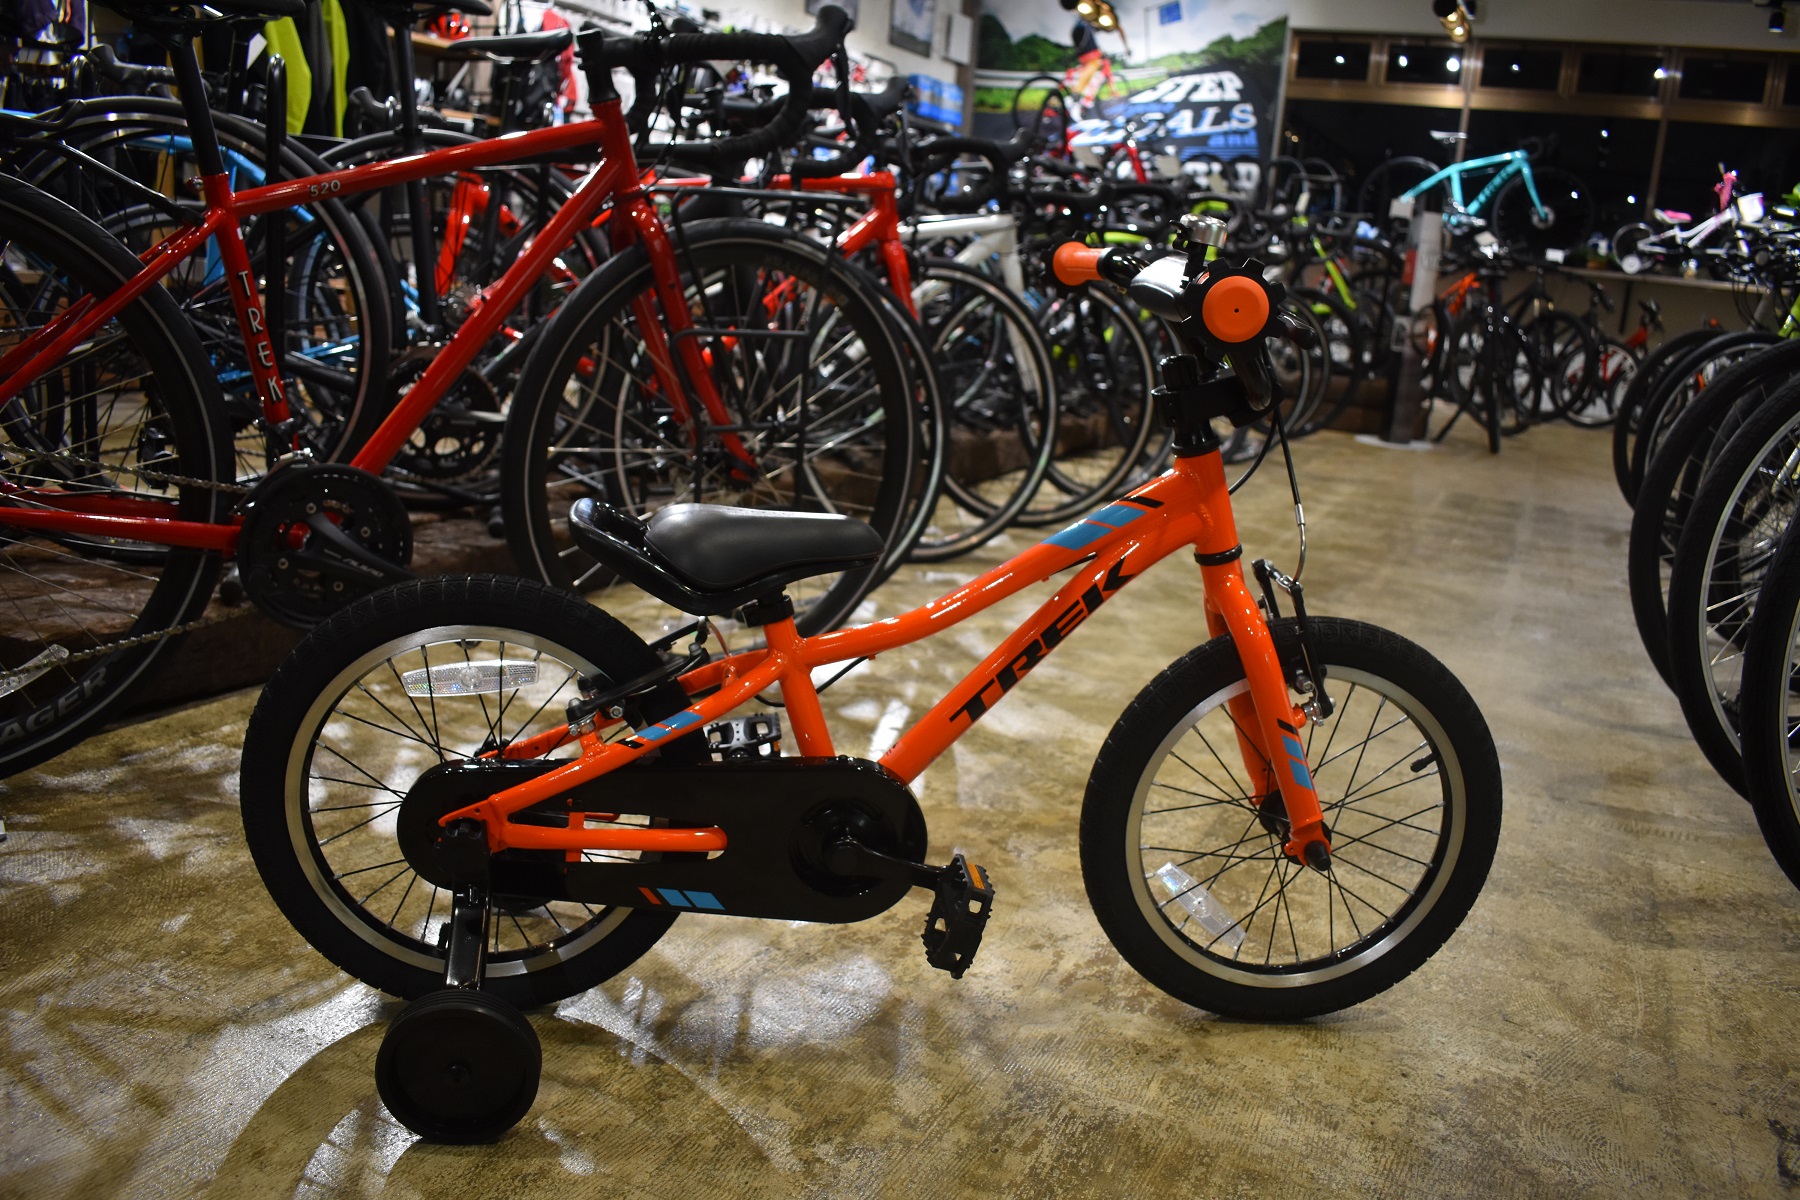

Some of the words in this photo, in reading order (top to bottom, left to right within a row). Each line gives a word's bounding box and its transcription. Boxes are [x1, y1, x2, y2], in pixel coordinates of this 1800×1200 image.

[1128, 70, 1244, 104] STEP
[310, 179, 341, 197] 520
[238, 270, 283, 402] TREK
[949, 556, 1135, 723] TREK
